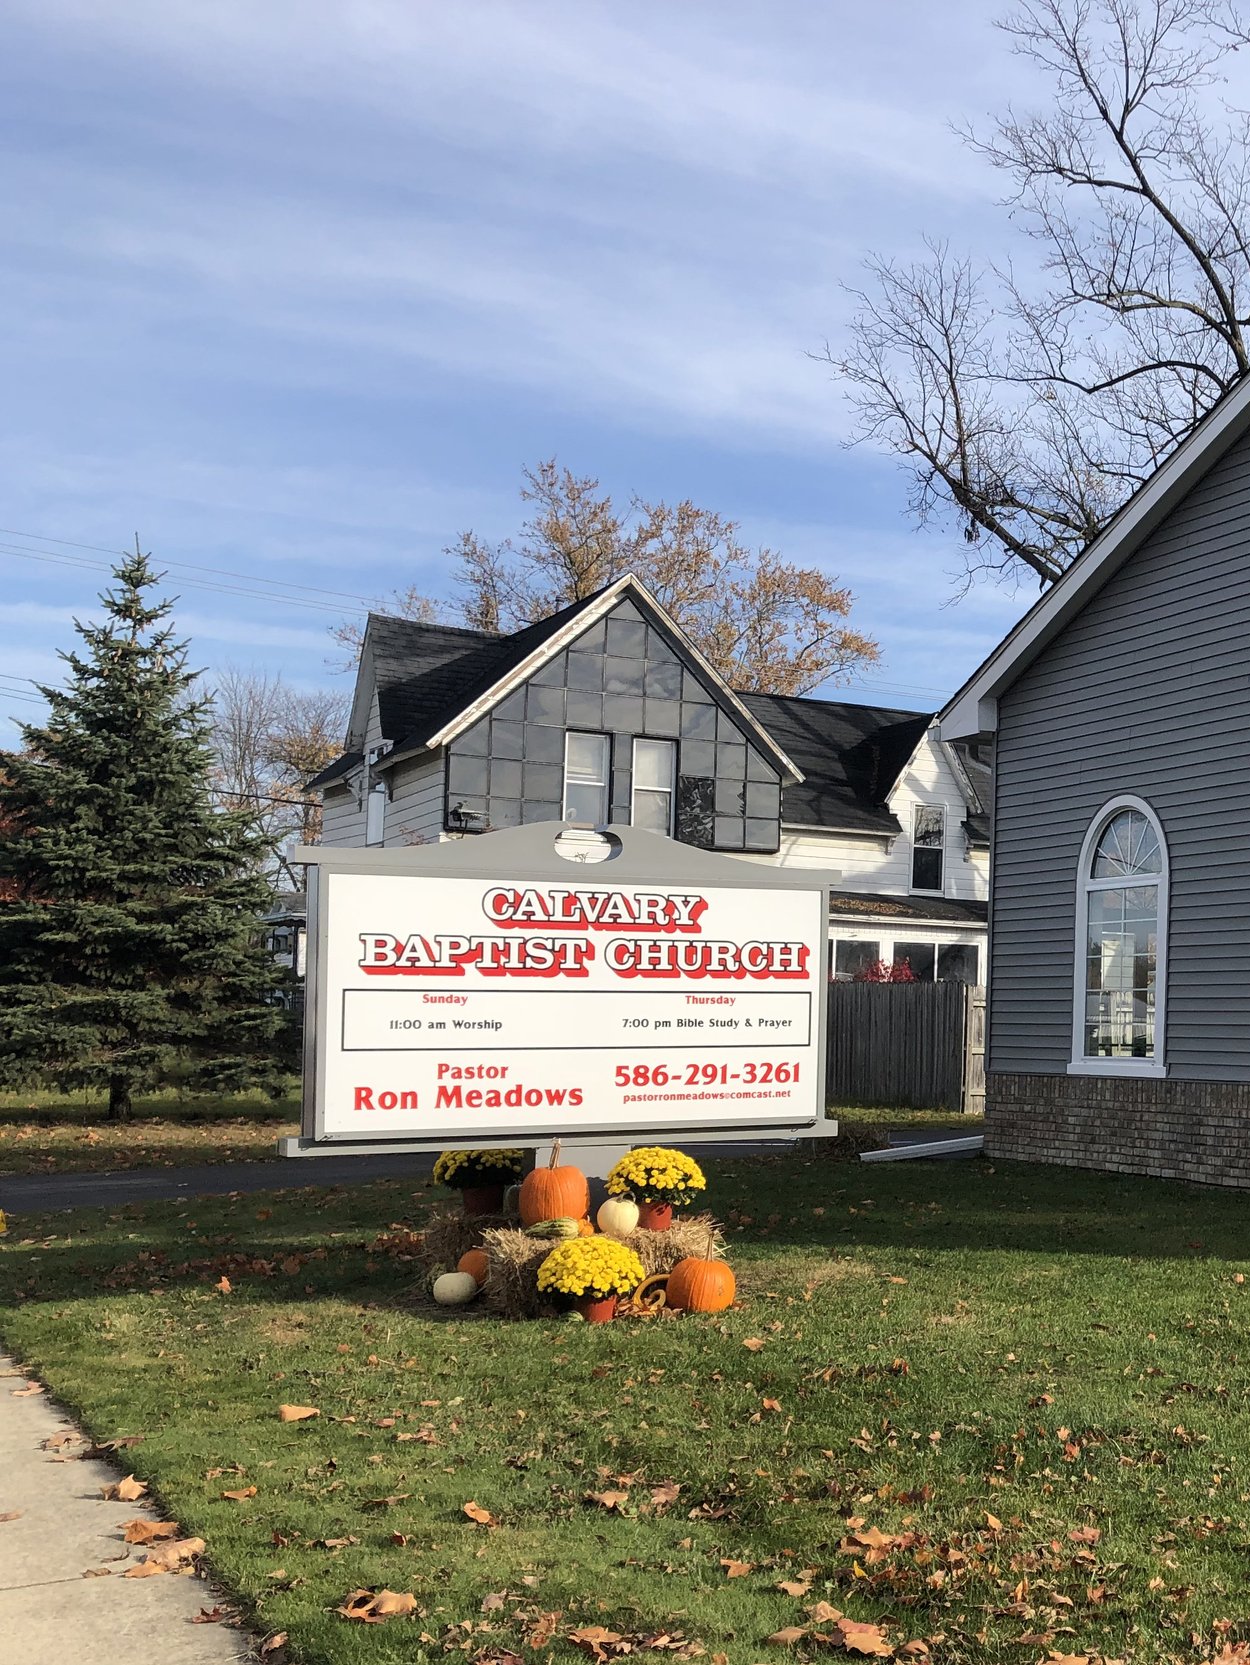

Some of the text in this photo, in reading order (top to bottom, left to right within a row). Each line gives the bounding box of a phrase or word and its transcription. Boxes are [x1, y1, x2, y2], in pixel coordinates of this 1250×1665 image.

[482, 886, 708, 934] CALVARY
[358, 932, 811, 981] BAPTIST CHURCH
[422, 993, 468, 1006] Sunday
[685, 995, 736, 1006] Thursday
[389, 1019, 503, 1032] 11:00 am Worship
[622, 1018, 793, 1030] 7:00 pm Bible Study & Prayer
[437, 1063, 509, 1080] Pastor
[614, 1061, 800, 1088] 586-291-3261
[353, 1083, 583, 1111] Ron Meadows
